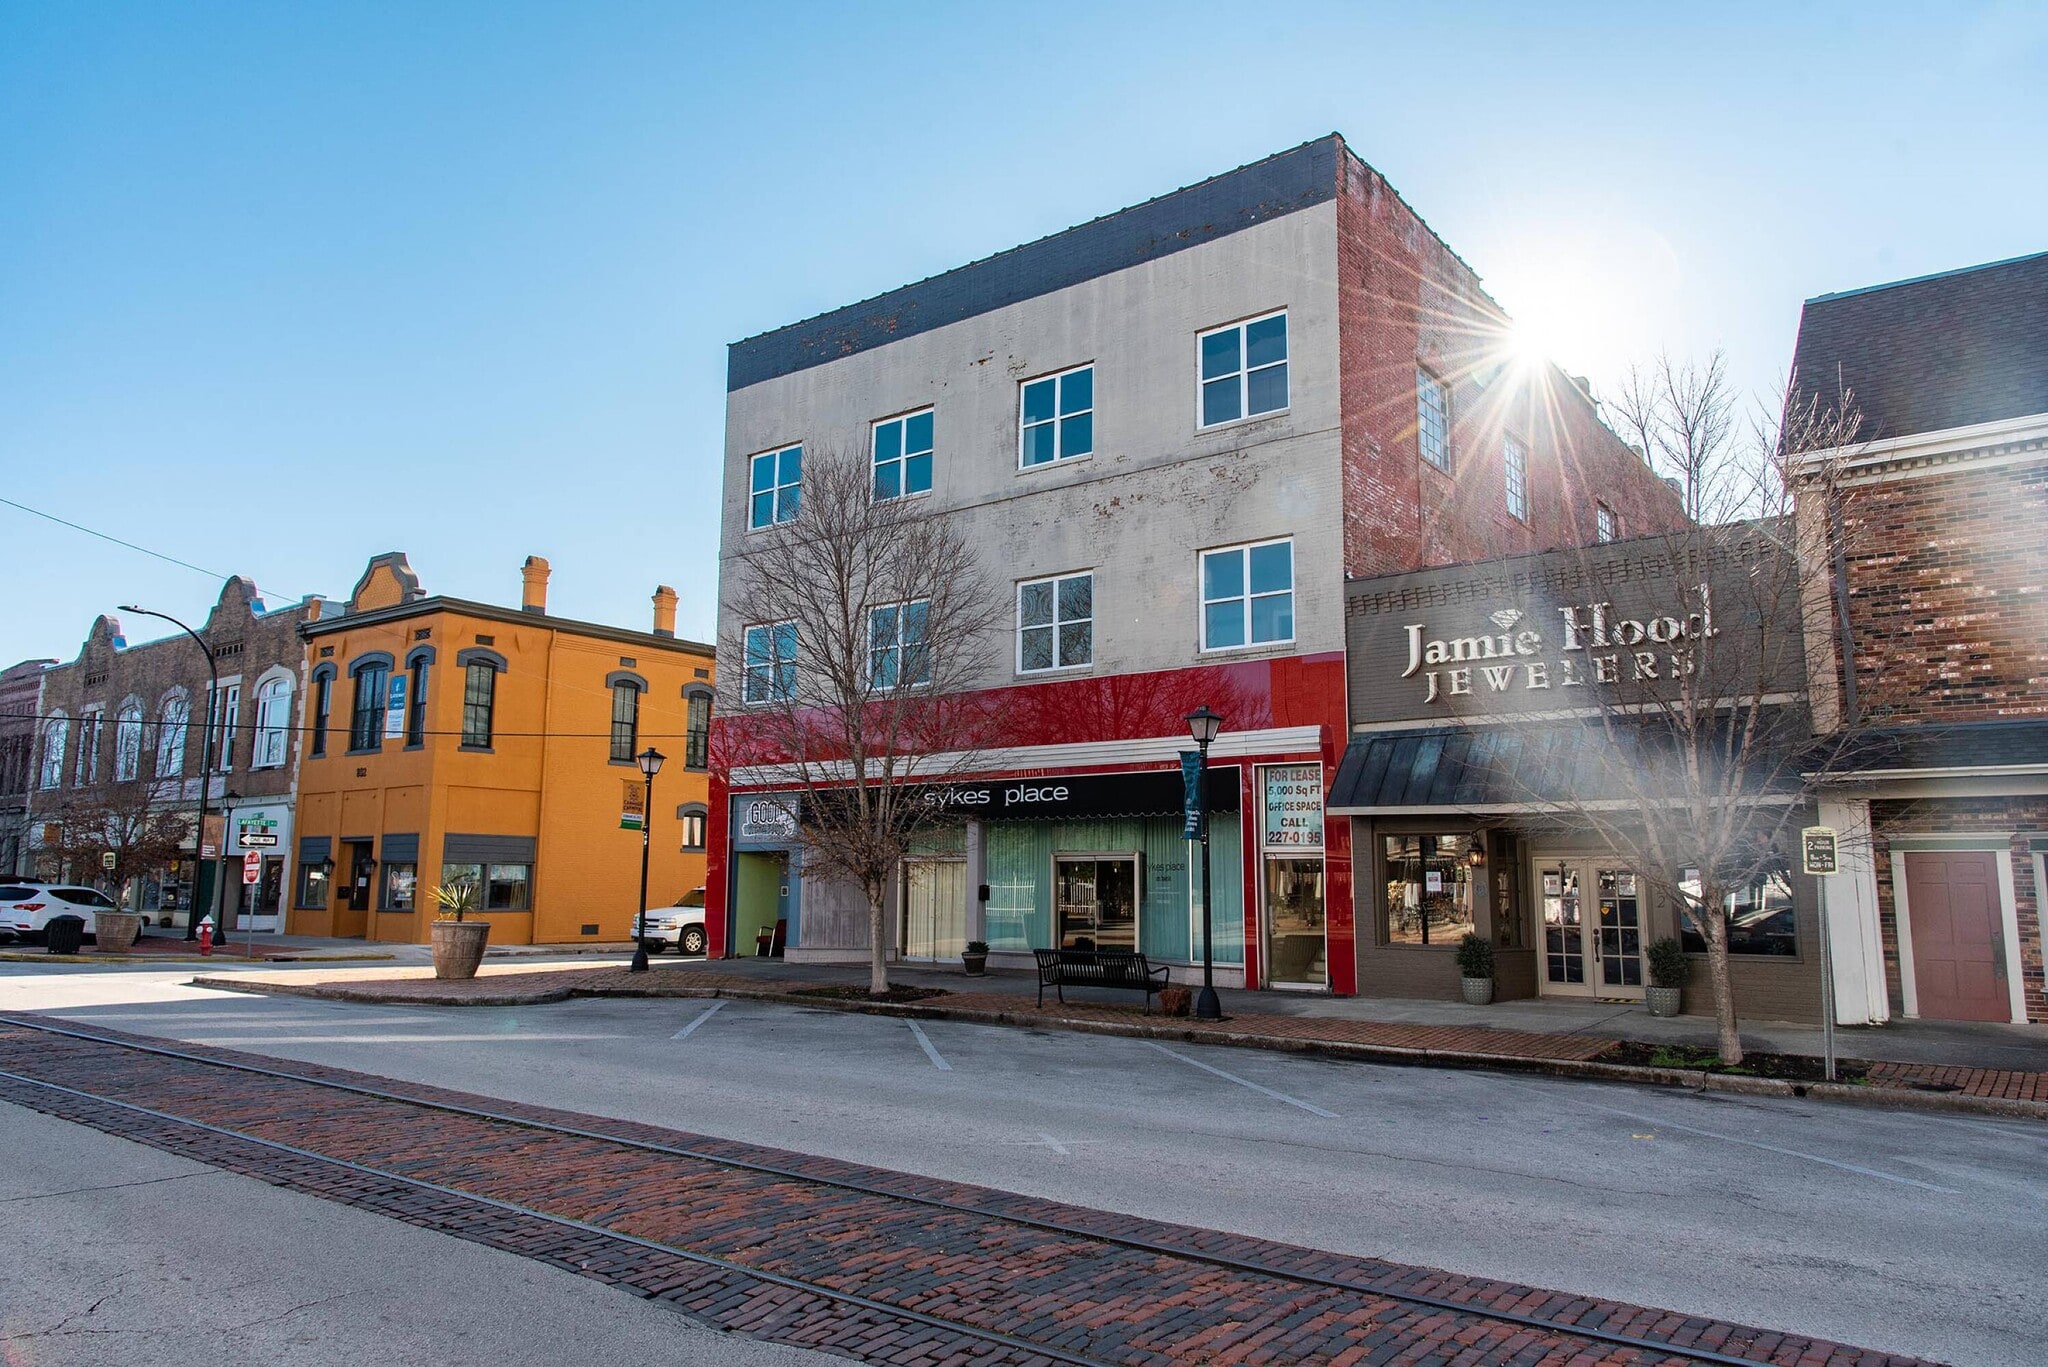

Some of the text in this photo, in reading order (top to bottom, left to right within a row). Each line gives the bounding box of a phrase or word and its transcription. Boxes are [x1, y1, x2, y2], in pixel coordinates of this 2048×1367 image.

[1401, 582, 1720, 678] Jamie Hood
[1424, 647, 1695, 704] JEWELERS
[1269, 768, 1320, 782] FOR LEASE
[923, 784, 1069, 808] sykes place
[1268, 785, 1321, 797] 5,000 Sq FT
[1268, 802, 1321, 812] OFFICE SPACE
[1268, 831, 1321, 844] 227-0195
[1807, 841, 1814, 850] 2
